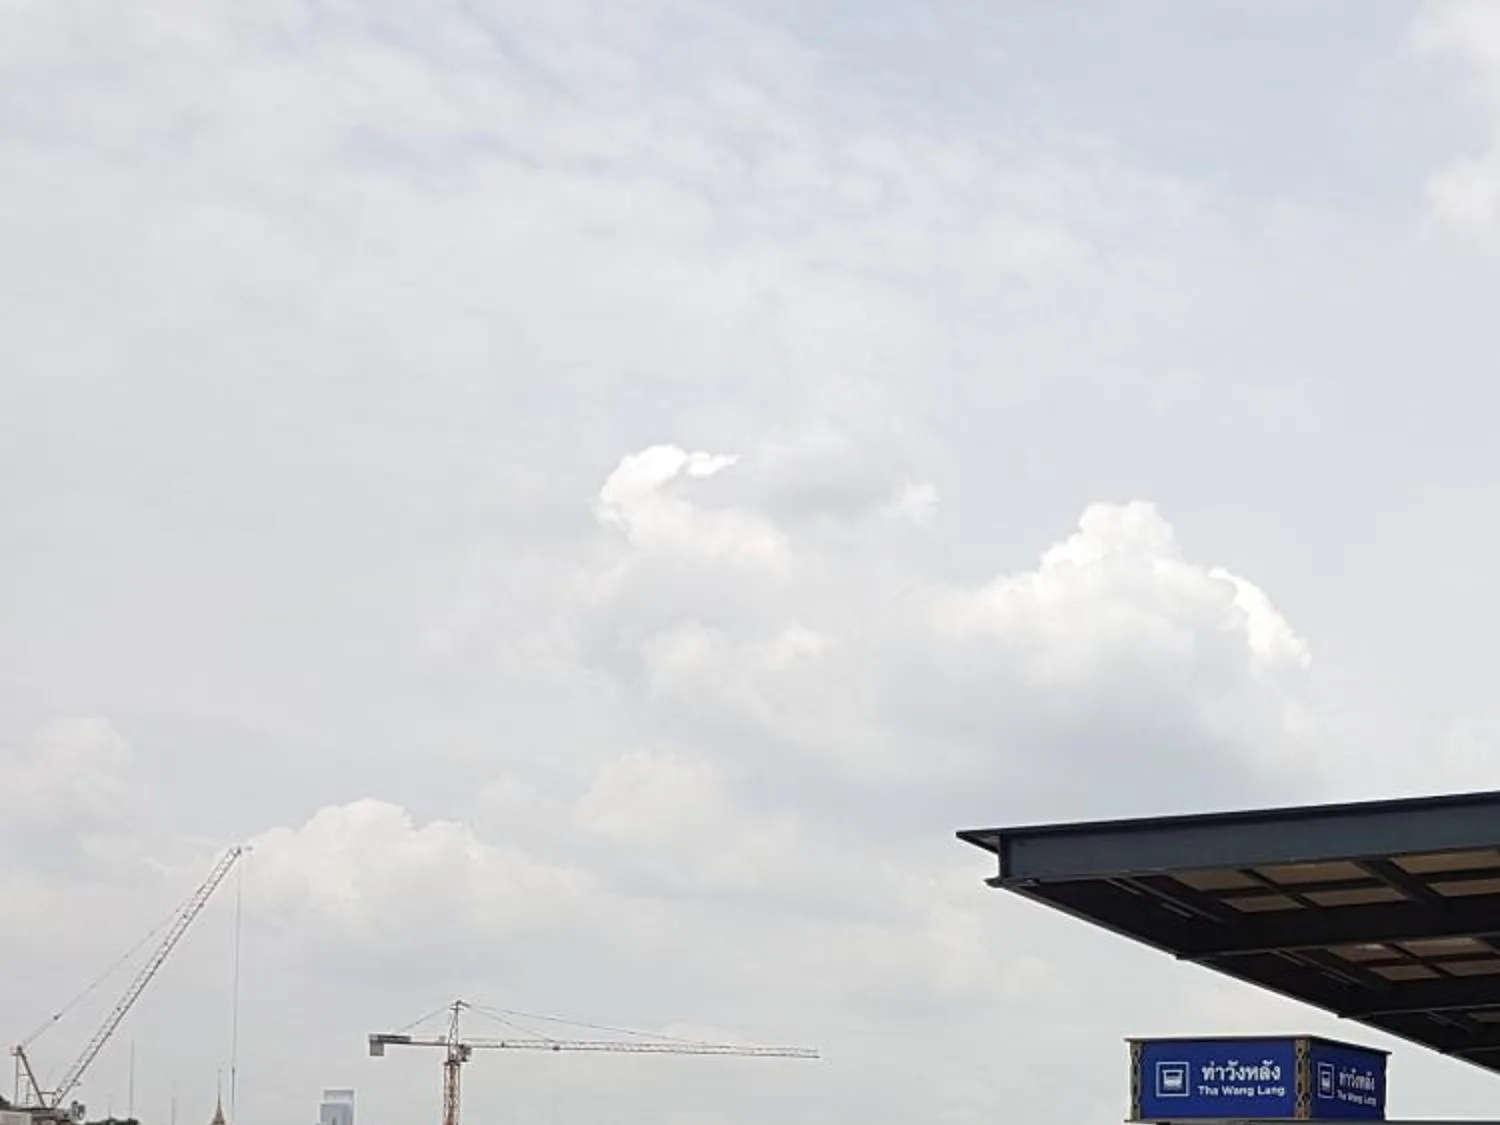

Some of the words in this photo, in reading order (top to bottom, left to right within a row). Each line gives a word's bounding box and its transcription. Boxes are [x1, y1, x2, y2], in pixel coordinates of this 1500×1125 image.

[1201, 1060, 1281, 1081] ท่าวังหลัง
[1198, 1085, 1219, 1096] Tha
[1221, 1085, 1254, 1097] Wang
[1257, 1085, 1285, 1097] Lang
